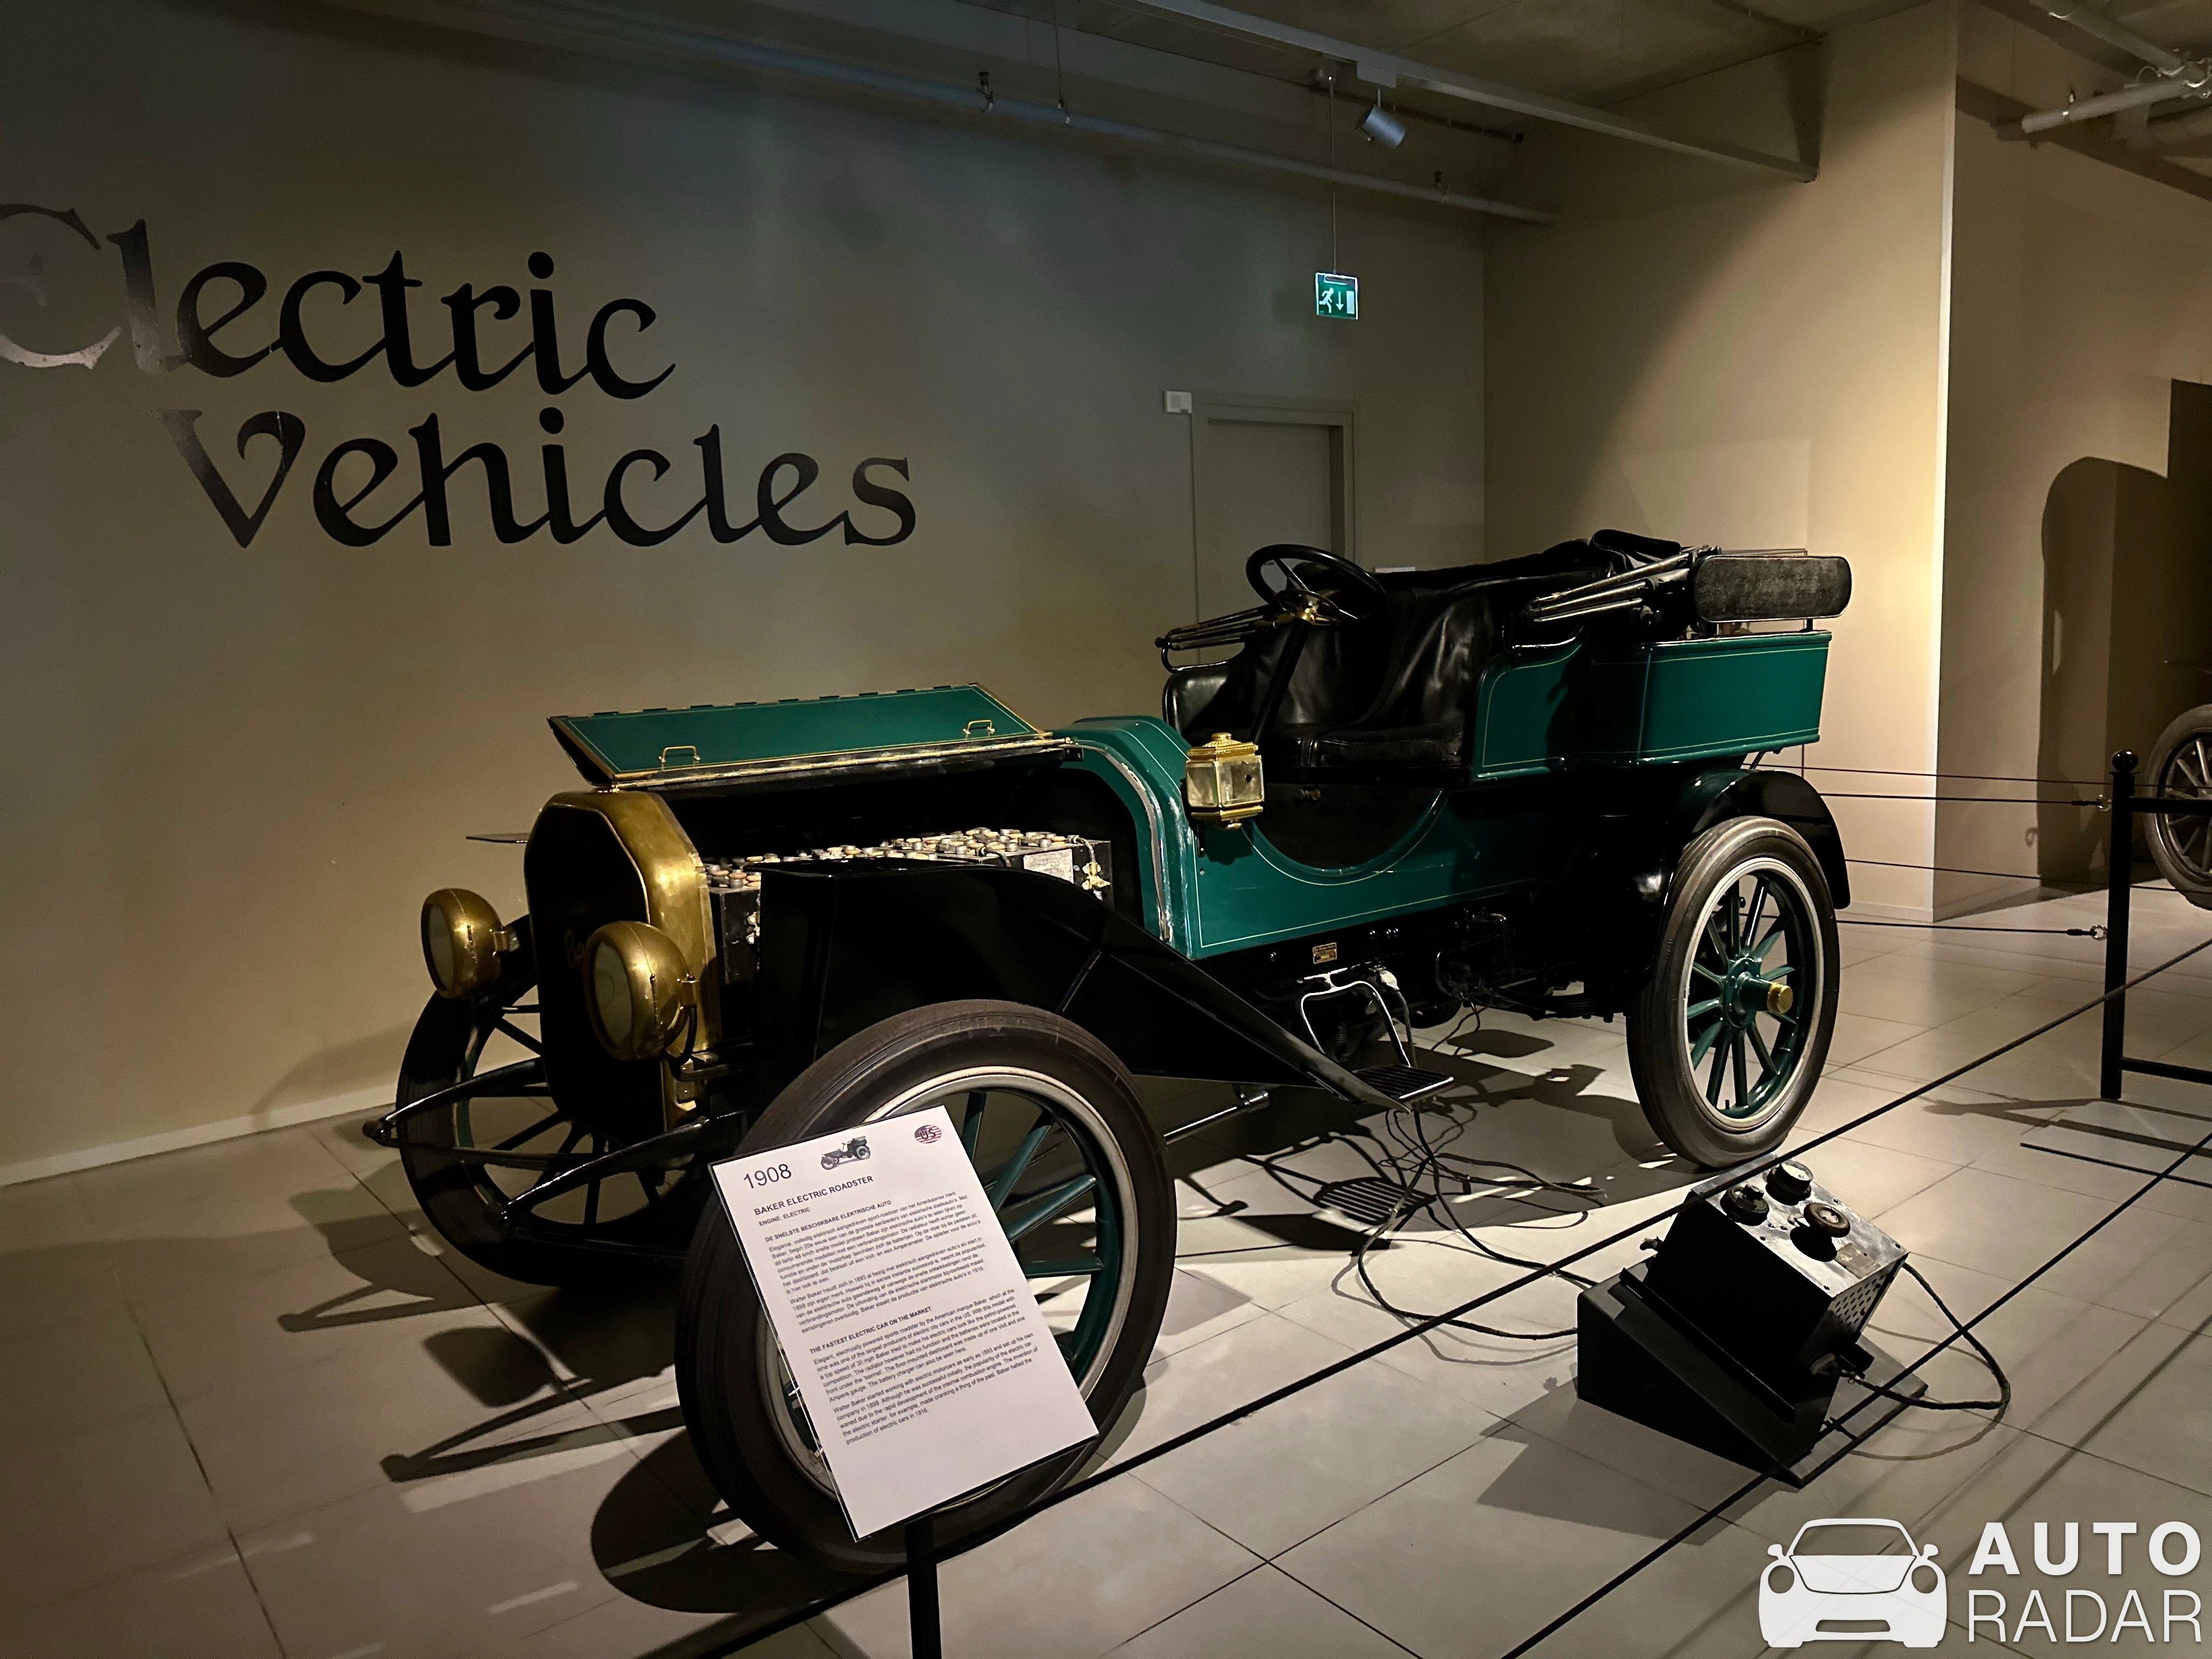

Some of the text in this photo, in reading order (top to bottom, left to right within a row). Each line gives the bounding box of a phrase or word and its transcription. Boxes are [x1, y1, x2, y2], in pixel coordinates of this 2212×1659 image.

[149, 407, 916, 549] Vehicles
[919, 1128, 936, 1140] US
[743, 1164, 792, 1189] 1908
[754, 1176, 874, 1215] BAKER ELECTRIC ROADSTER
[774, 1228, 800, 1239] SNELSTE
[800, 1216, 840, 1231] BESCHIKBARE
[840, 1205, 877, 1219] ELEKTRISCHE
[783, 1207, 810, 1218] ELECTRIC
[822, 1336, 847, 1349] FASTEST
[848, 1327, 876, 1340] ELECTRIC
[909, 1306, 932, 1318] MARKET
[834, 1365, 850, 1374] speed
[930, 1330, 946, 1338] electric
[984, 1304, 1016, 1319] petrol-powered
[836, 1345, 861, 1356] electrically
[862, 1336, 883, 1348] powered
[884, 1331, 899, 1339] sports
[900, 1324, 918, 1333] roadster
[935, 1310, 956, 1321] American
[956, 1304, 973, 1312] marque
[865, 1362, 883, 1371] radiator
[884, 1353, 905, 1364] however
[922, 1340, 941, 1349] function
[959, 1326, 979, 1336] batteries
[990, 1314, 1007, 1324] located
[830, 1392, 849, 1402] Ampere
[878, 1374, 895, 1383] battery
[896, 1367, 915, 1376] charger
[833, 1404, 850, 1413] Walter
[851, 1398, 866, 1406] Baker
[867, 1390, 884, 1400] started
[884, 1383, 904, 1393] working
[915, 1372, 932, 1381] electric
[933, 1363, 956, 1374] motorcars
[837, 1409, 860, 1420] company
[882, 1392, 904, 1403] Although
[922, 1374, 946, 1387] successful
[973, 1356, 994, 1368] popularity
[1008, 1345, 1024, 1353] electric
[853, 1423, 871, 1432] electric
[935, 1389, 955, 1400] cranking
[1010, 1361, 1025, 1369] halted
[846, 1431, 873, 1445] production
[880, 1421, 898, 1430] electric
